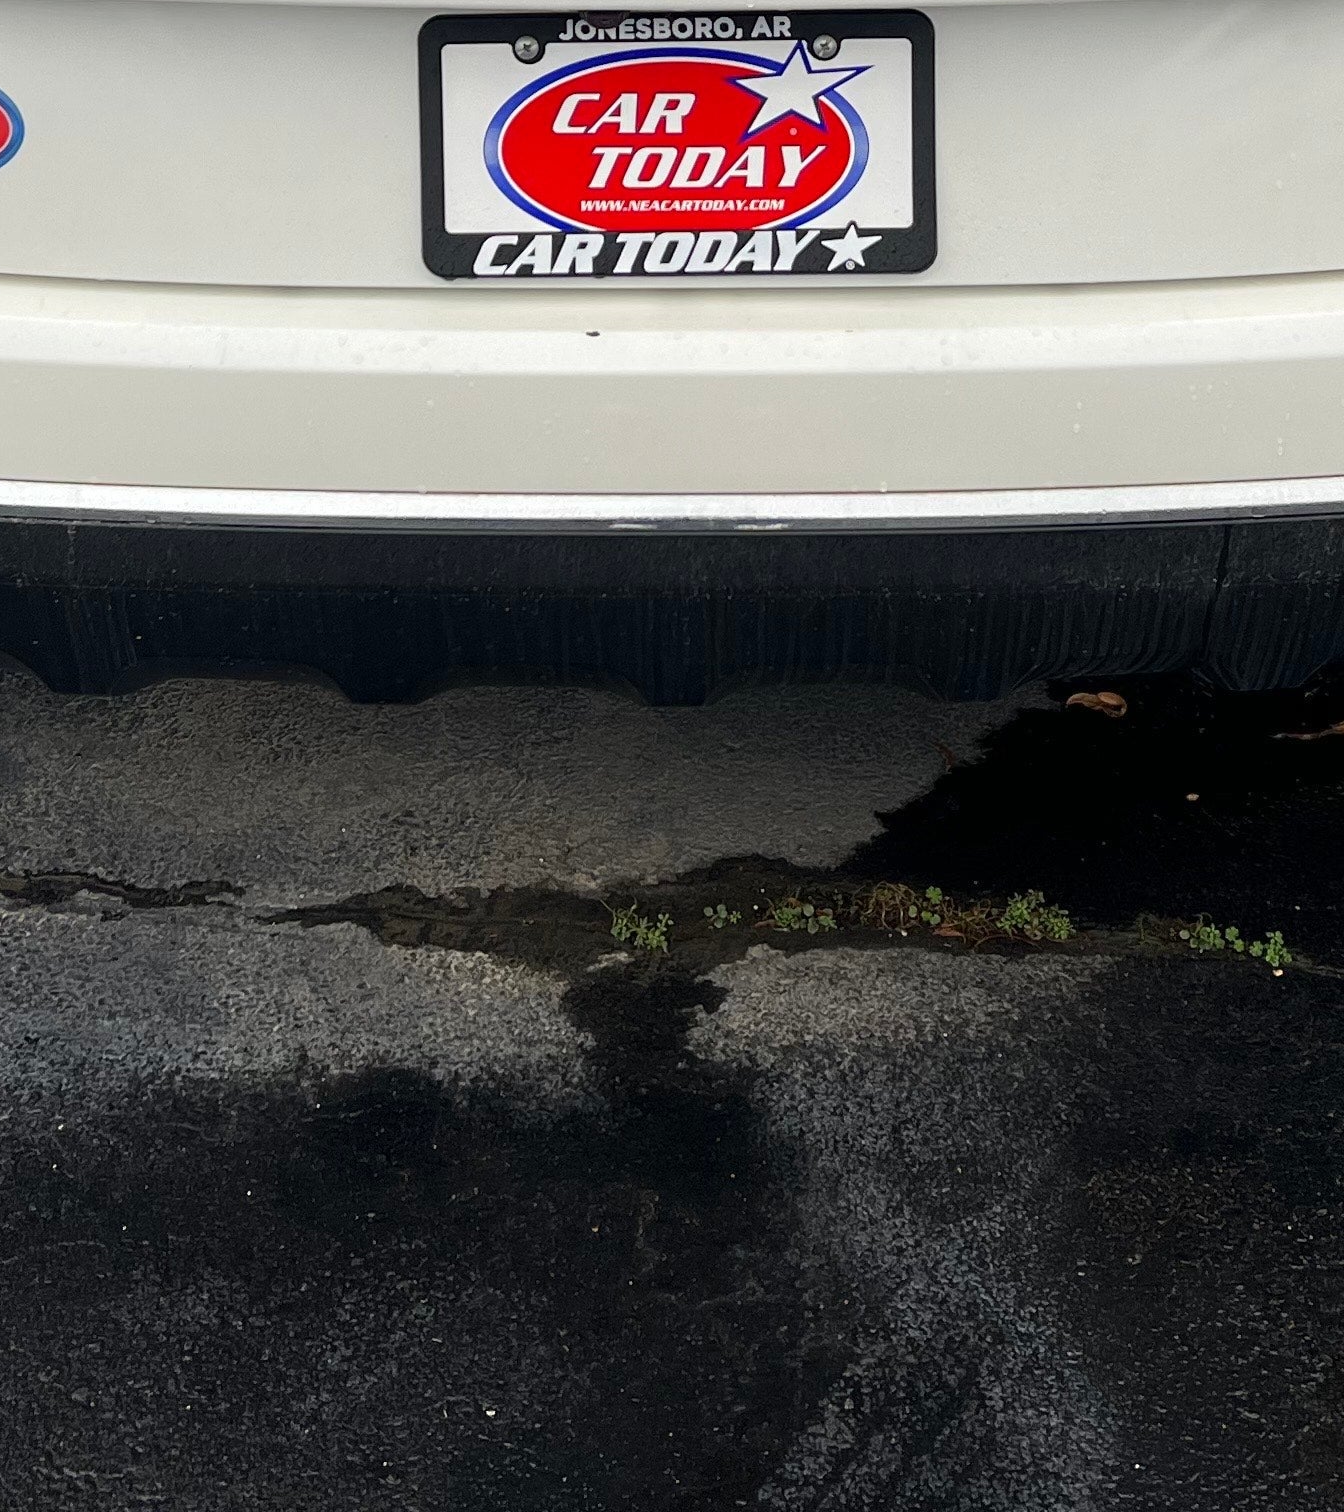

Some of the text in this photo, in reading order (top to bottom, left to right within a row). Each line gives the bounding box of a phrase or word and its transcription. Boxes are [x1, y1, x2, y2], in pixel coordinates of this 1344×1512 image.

[751, 16, 792, 38] AR
[552, 92, 696, 135] CAR
[588, 145, 827, 189] TODAY
[580, 199, 785, 212] WWW.NEACARTODAY.COM
[473, 229, 822, 276] CAR TODAY
